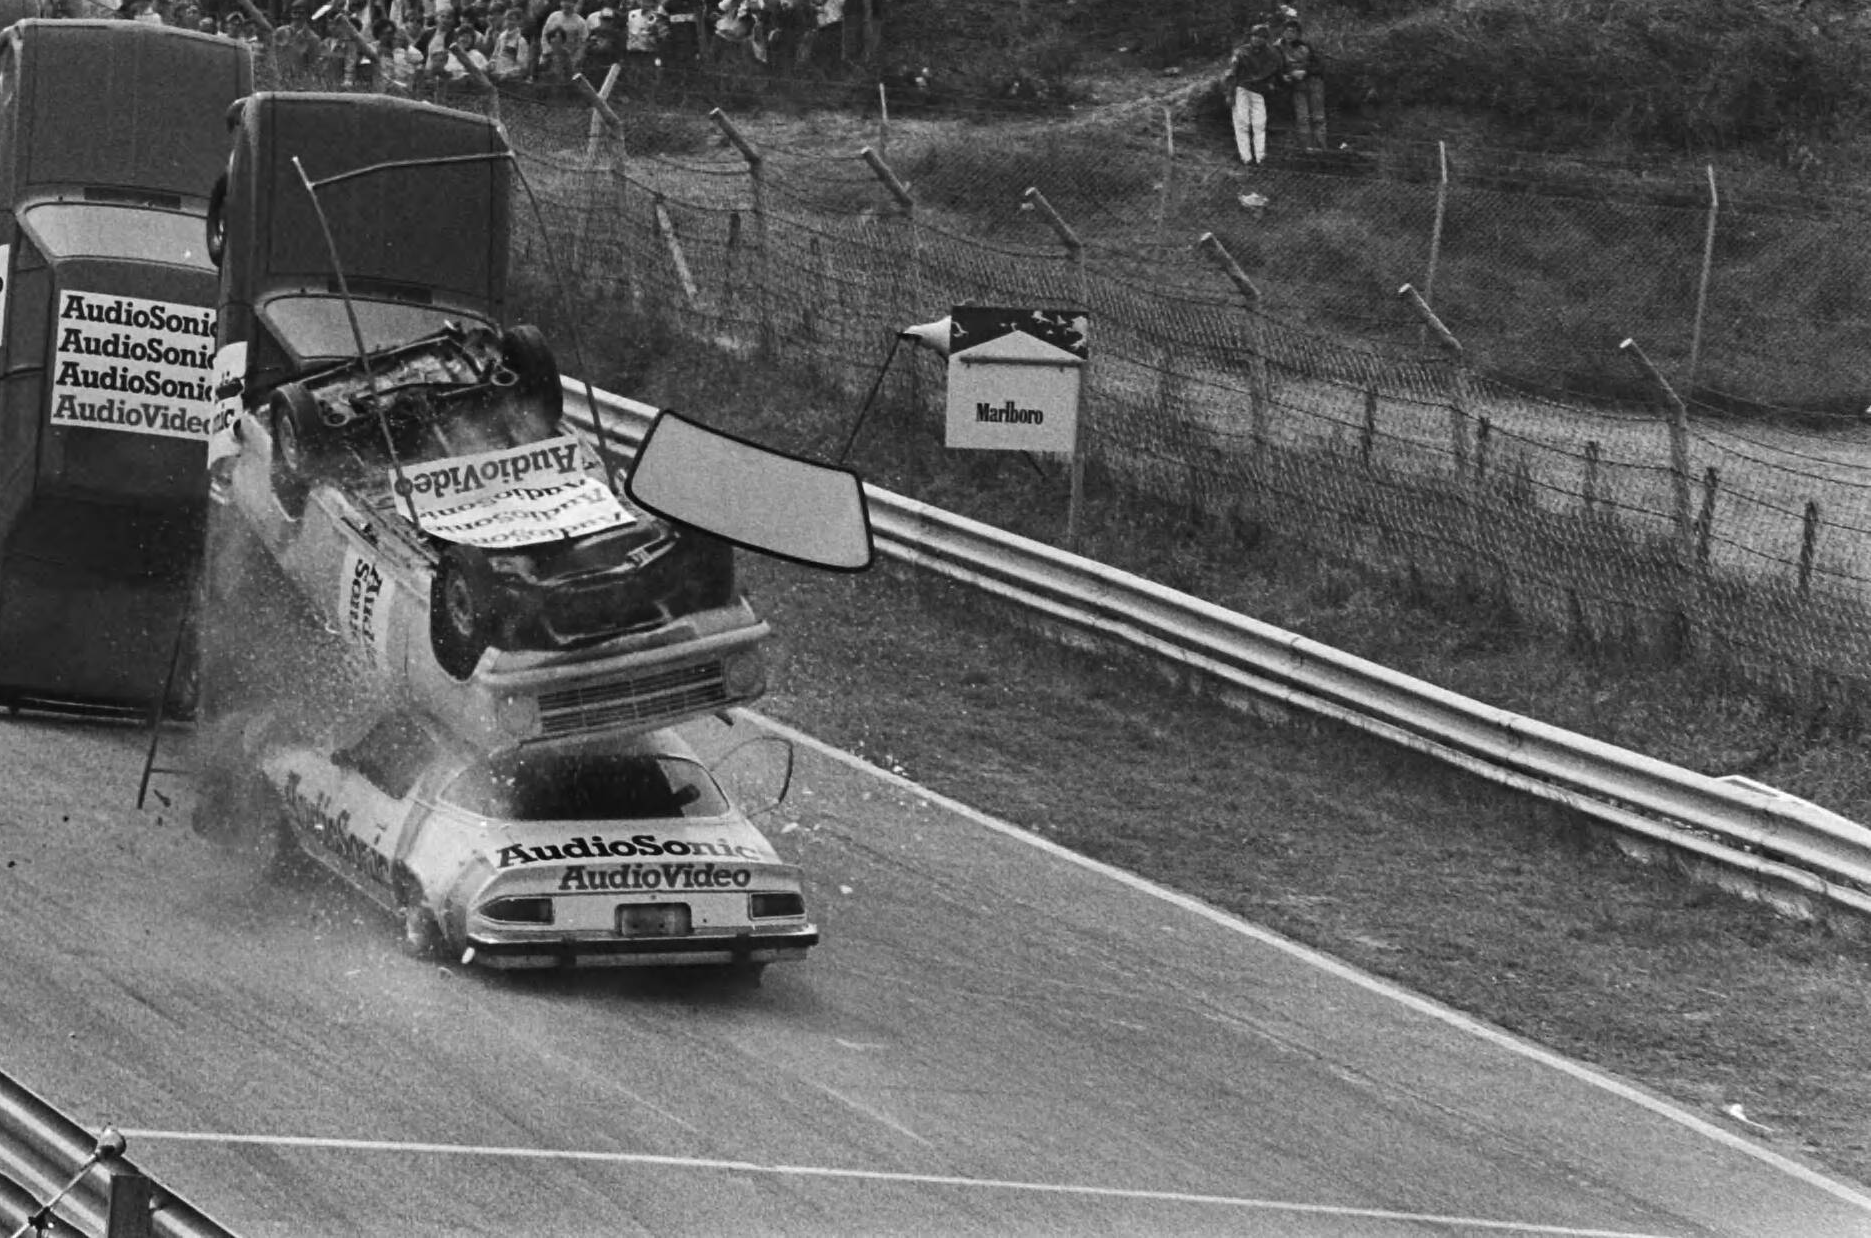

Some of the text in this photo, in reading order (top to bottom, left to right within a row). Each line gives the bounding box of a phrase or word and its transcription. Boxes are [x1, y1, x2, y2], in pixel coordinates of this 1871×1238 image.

[975, 400, 1044, 425] Marlboro
[496, 834, 761, 869] AudioSonic
[557, 863, 752, 890] AudioVideo
